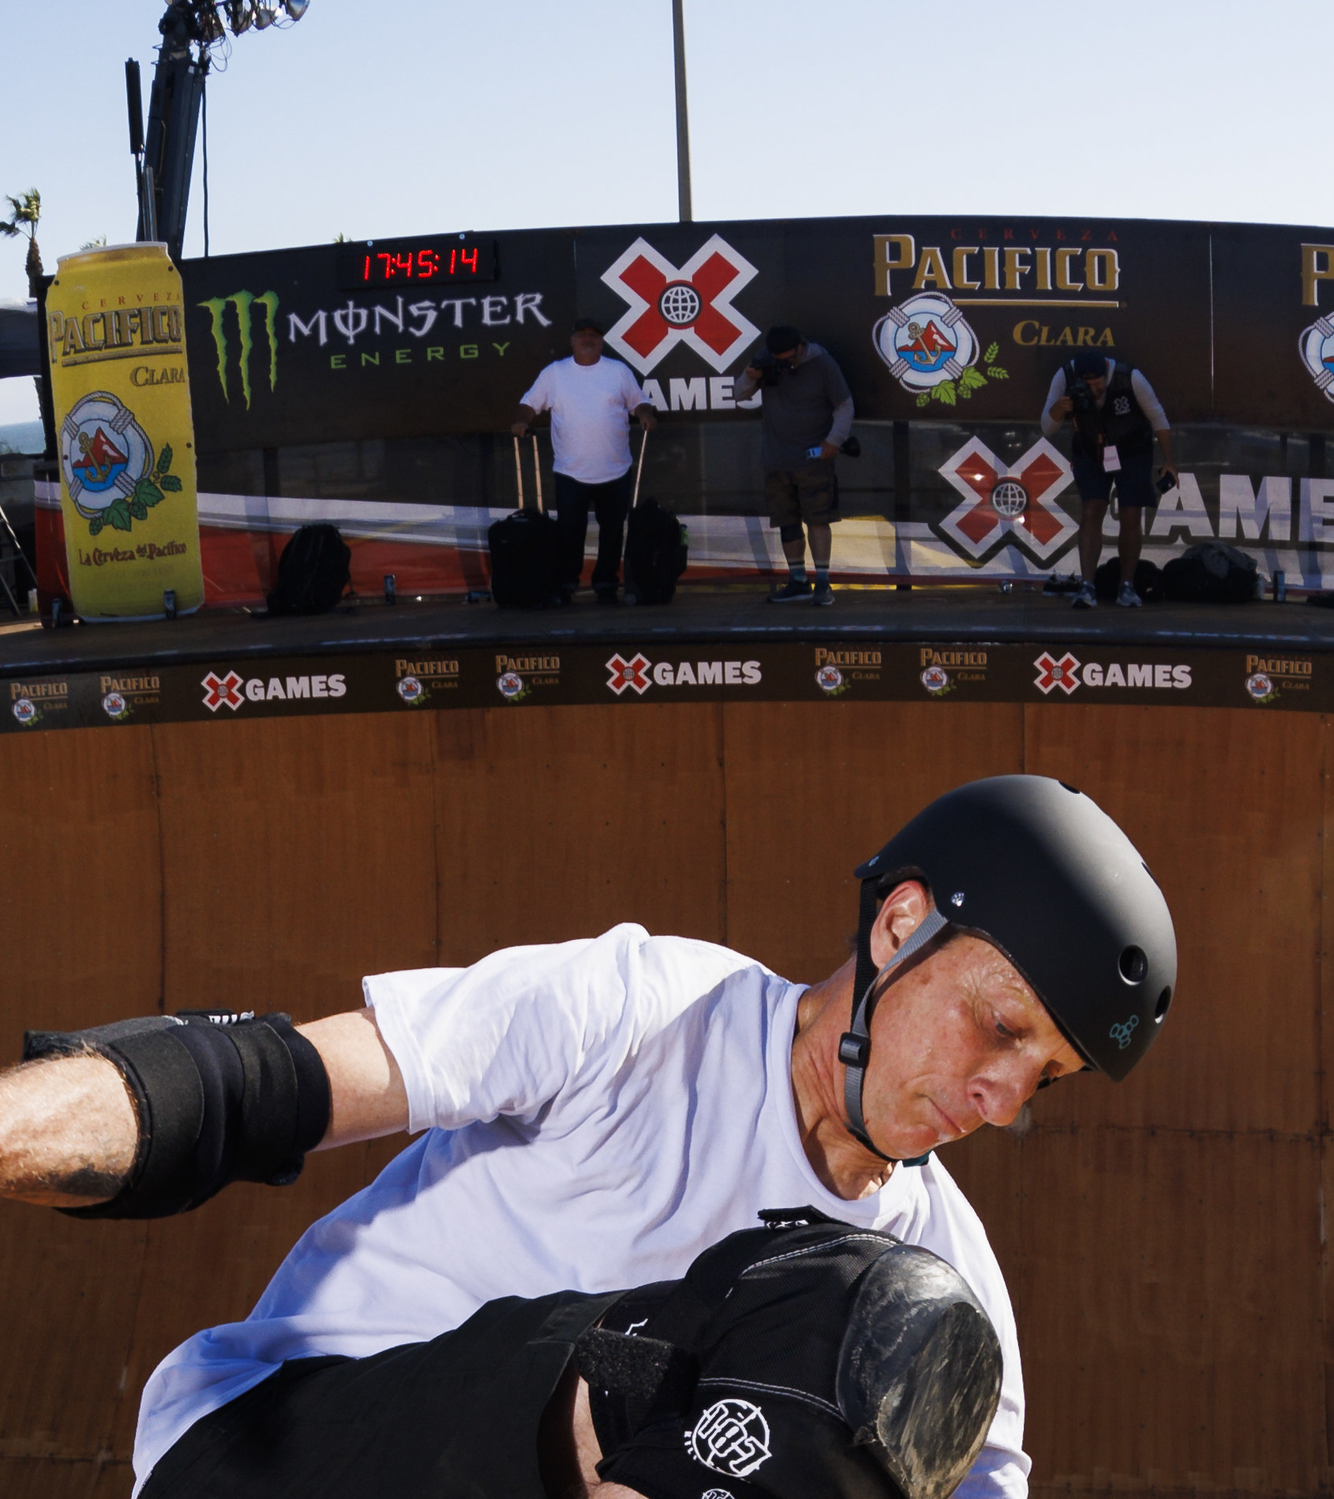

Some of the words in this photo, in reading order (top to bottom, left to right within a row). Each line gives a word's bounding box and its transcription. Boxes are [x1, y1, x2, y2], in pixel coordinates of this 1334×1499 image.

[950, 228, 1118, 241] CERVEZA
[364, 248, 478, 281] 17:45:14
[872, 234, 1121, 297] PACIFICO
[287, 292, 552, 346] MONSTER
[49, 304, 182, 364] PACIFICO
[1013, 319, 1116, 347] CLARA
[331, 342, 510, 369] ENERGY
[130, 365, 186, 386] CLARA
[642, 376, 763, 412] AME
[77, 548, 92, 567] La
[92, 547, 136, 567] Cerveza
[395, 659, 459, 677] PACIFICO
[495, 654, 560, 673] PACIFICO
[815, 647, 882, 666] PACIFICO
[920, 647, 987, 666] PACIFICO
[1246, 654, 1312, 675] PACIFICO
[100, 676, 160, 694] PACIFICO
[653, 660, 762, 686] GAMES
[1082, 662, 1192, 690] GAMES
[10, 682, 68, 699] PACIFICO
[245, 673, 347, 702] GAMES
[697, 1403, 773, 1476] 187
